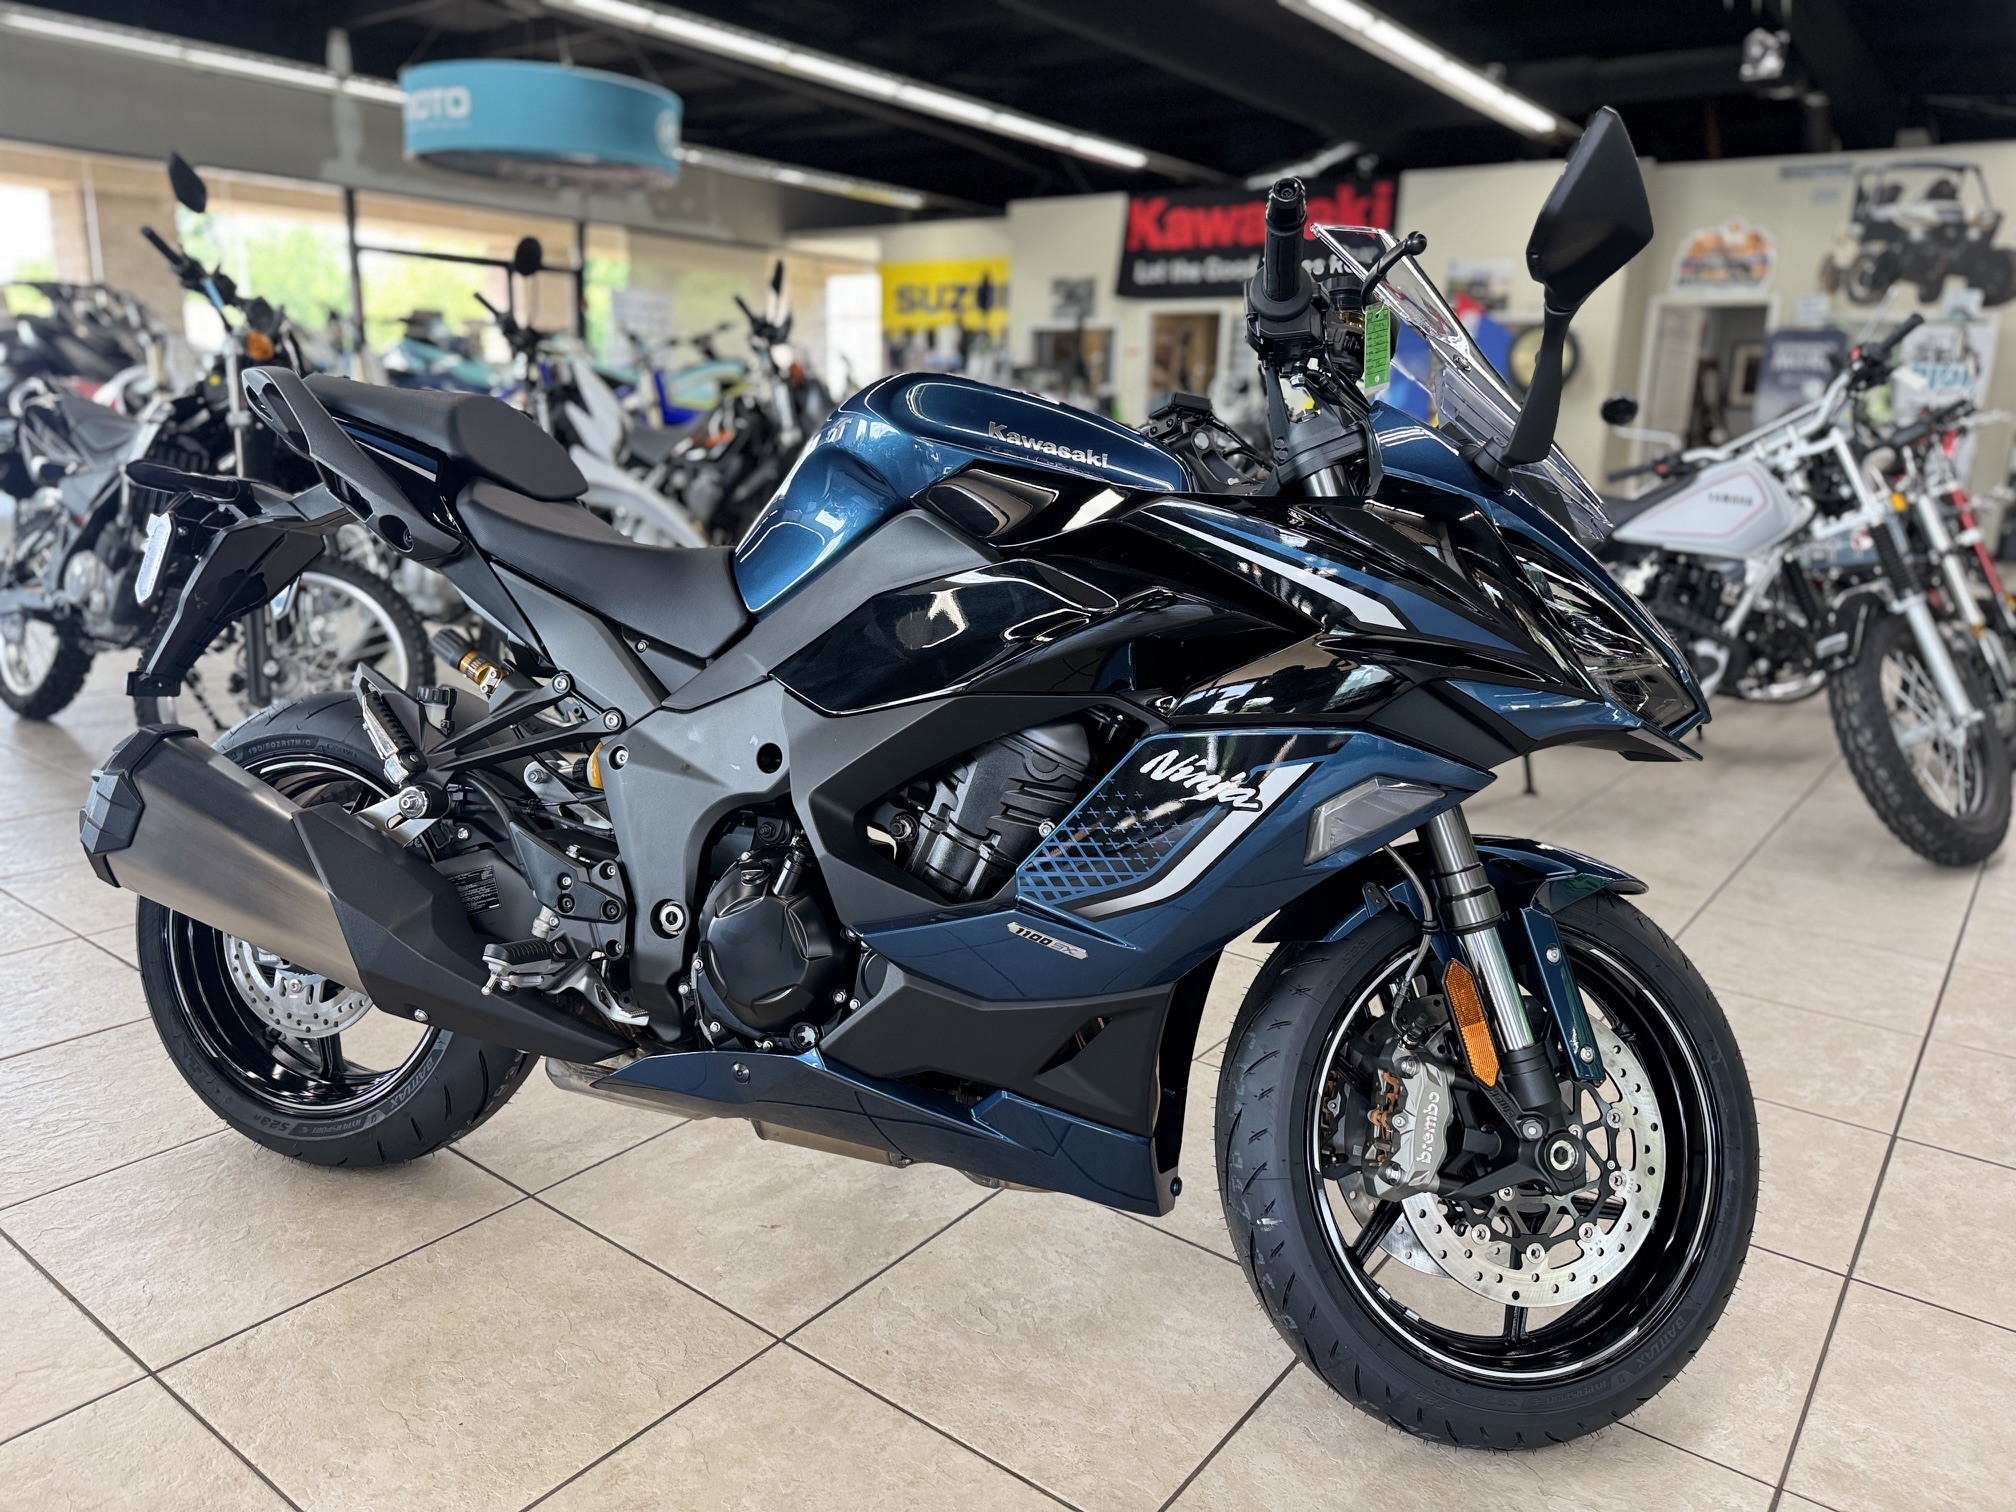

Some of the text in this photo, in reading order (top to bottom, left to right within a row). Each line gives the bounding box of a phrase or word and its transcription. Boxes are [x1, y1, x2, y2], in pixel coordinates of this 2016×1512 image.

[1127, 181, 1394, 254] Kawaaki
[988, 421, 1109, 468] Kawasaki
[1139, 749, 1263, 812] Ninja
[389, 1056, 435, 1110] BATTLAX
[1416, 1091, 1440, 1164] brembo
